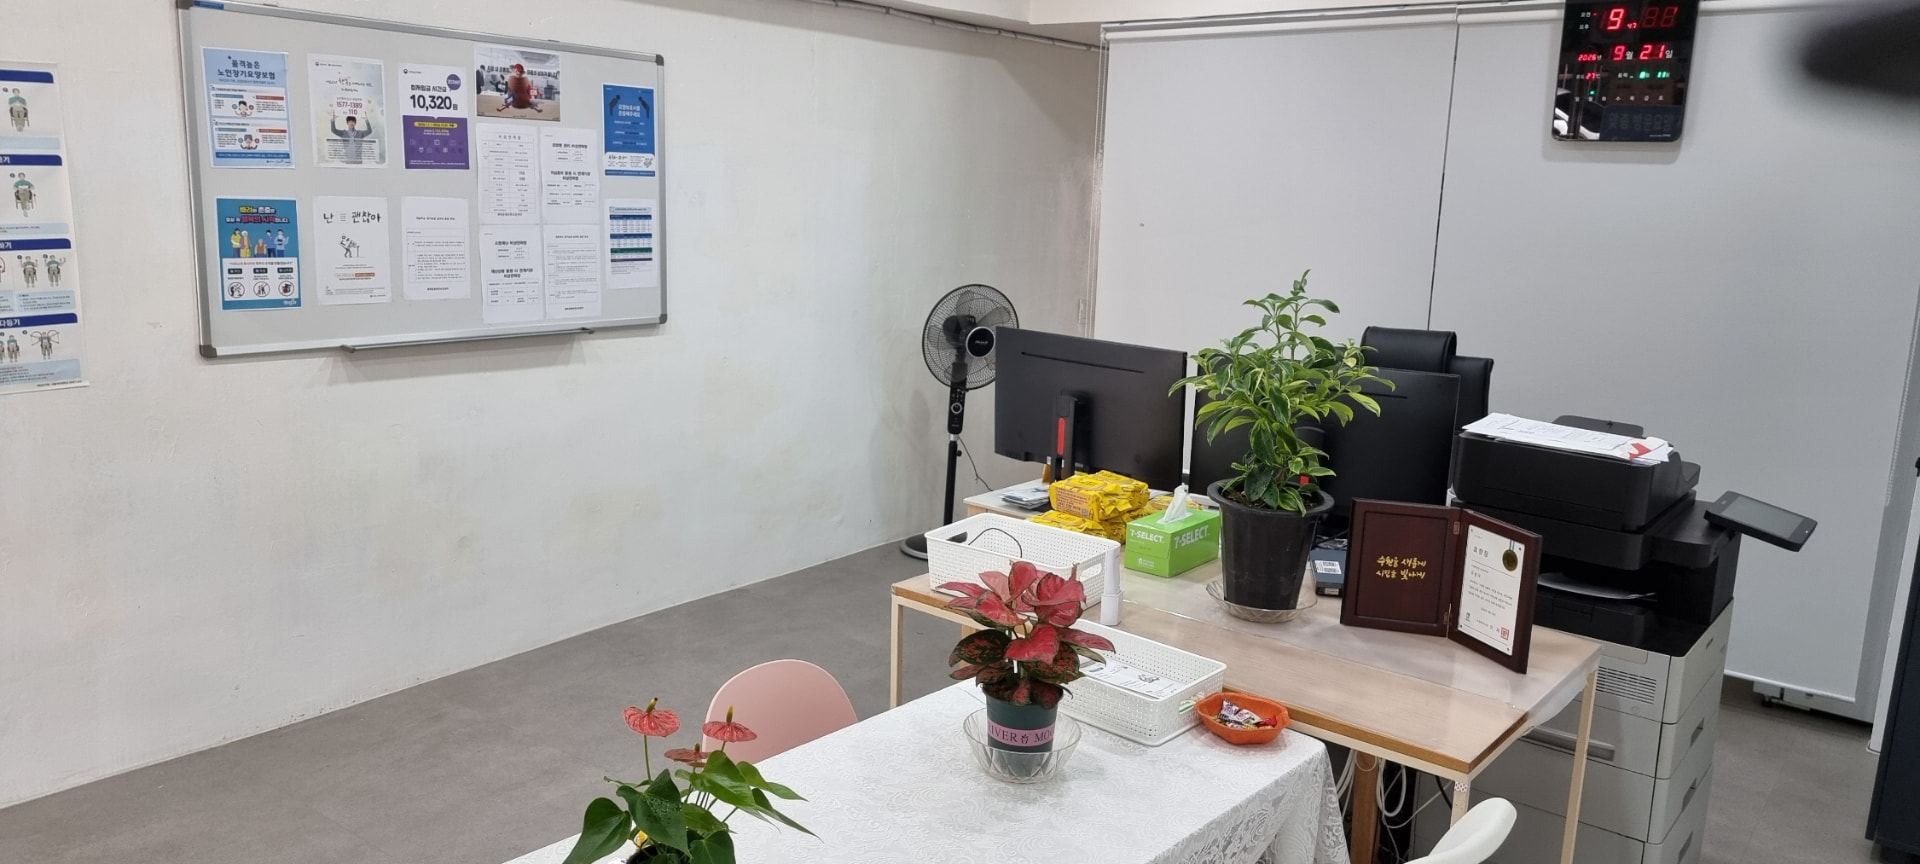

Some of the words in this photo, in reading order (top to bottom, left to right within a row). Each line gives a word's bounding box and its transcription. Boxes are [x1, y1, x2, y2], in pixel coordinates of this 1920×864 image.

[1607, 8, 1625, 30] 9
[231, 59, 261, 69] 품격높은
[217, 69, 276, 80] 노인장기요양보험
[336, 101, 363, 109] 1577-1389
[323, 212, 334, 224] 난
[351, 210, 381, 224] 괜찮아
[1376, 555, 1399, 568] 수원을
[1375, 569, 1398, 578] 시민을
[1400, 569, 1426, 580] 빛나게
[990, 724, 1018, 743] IVER
